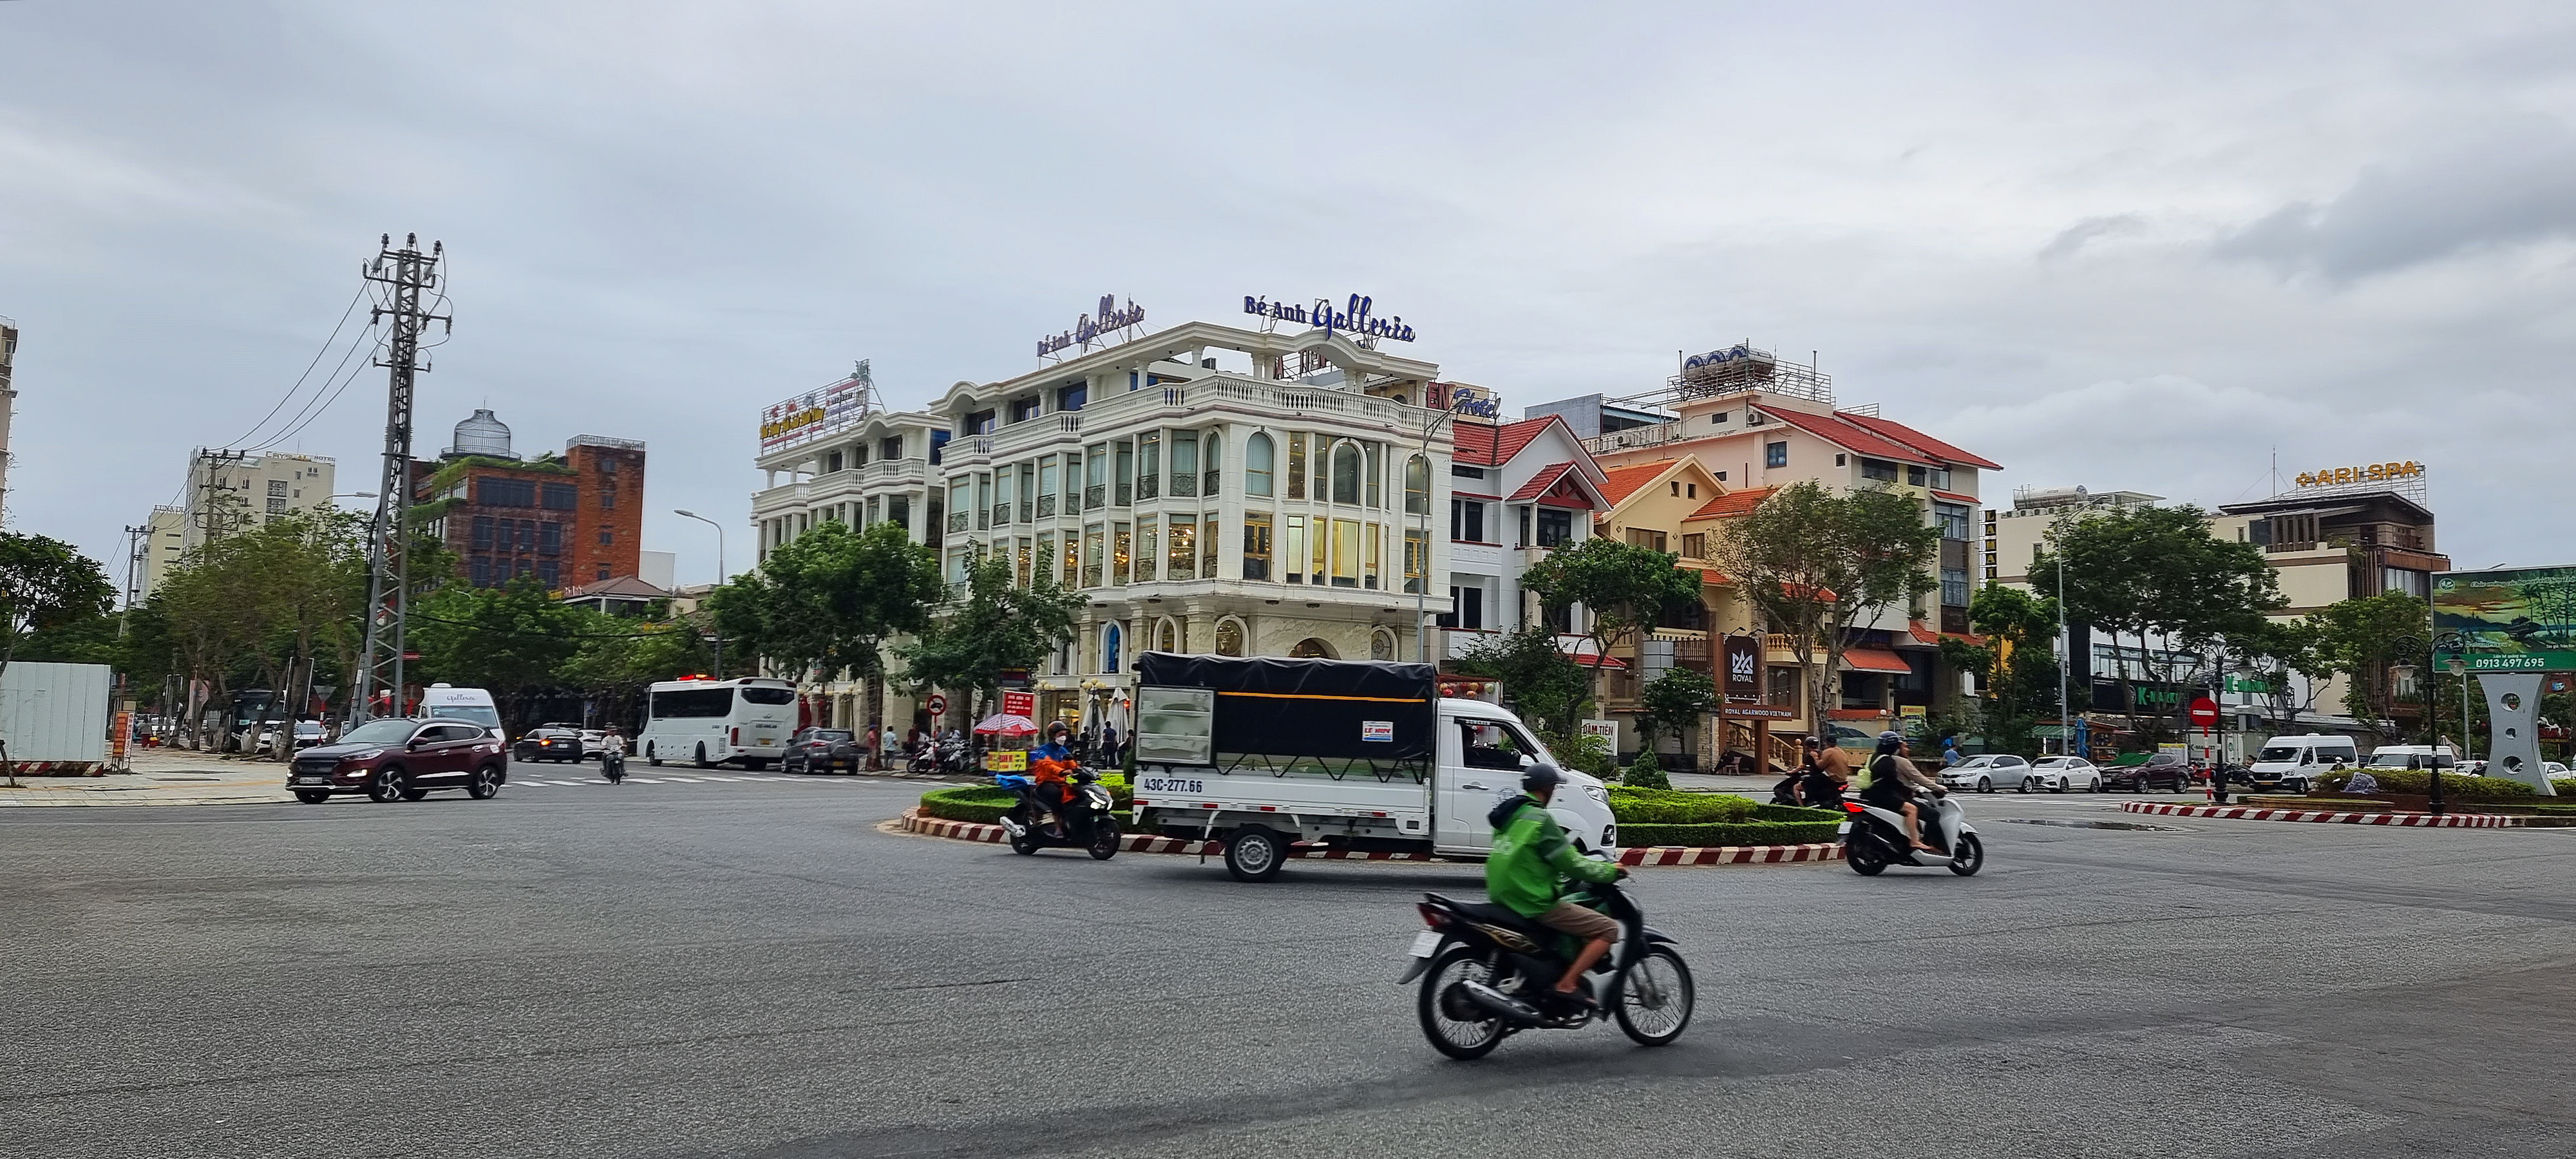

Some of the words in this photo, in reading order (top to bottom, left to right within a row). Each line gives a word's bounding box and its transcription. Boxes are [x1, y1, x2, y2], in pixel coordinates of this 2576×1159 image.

[1076, 294, 1144, 353] Galleria
[1244, 296, 1267, 315] Bé
[1273, 301, 1306, 323] Anh
[1312, 293, 1416, 342] Galleria
[1454, 388, 1501, 419] Hotel
[2315, 469, 2358, 485] ARI
[2367, 460, 2420, 481] SPA
[2476, 659, 2499, 668] 0913
[2502, 659, 2521, 667] 497
[2524, 658, 2544, 667] 695
[1732, 674, 1753, 683] ROYAL
[1144, 778, 1203, 793] 43C-277.66
